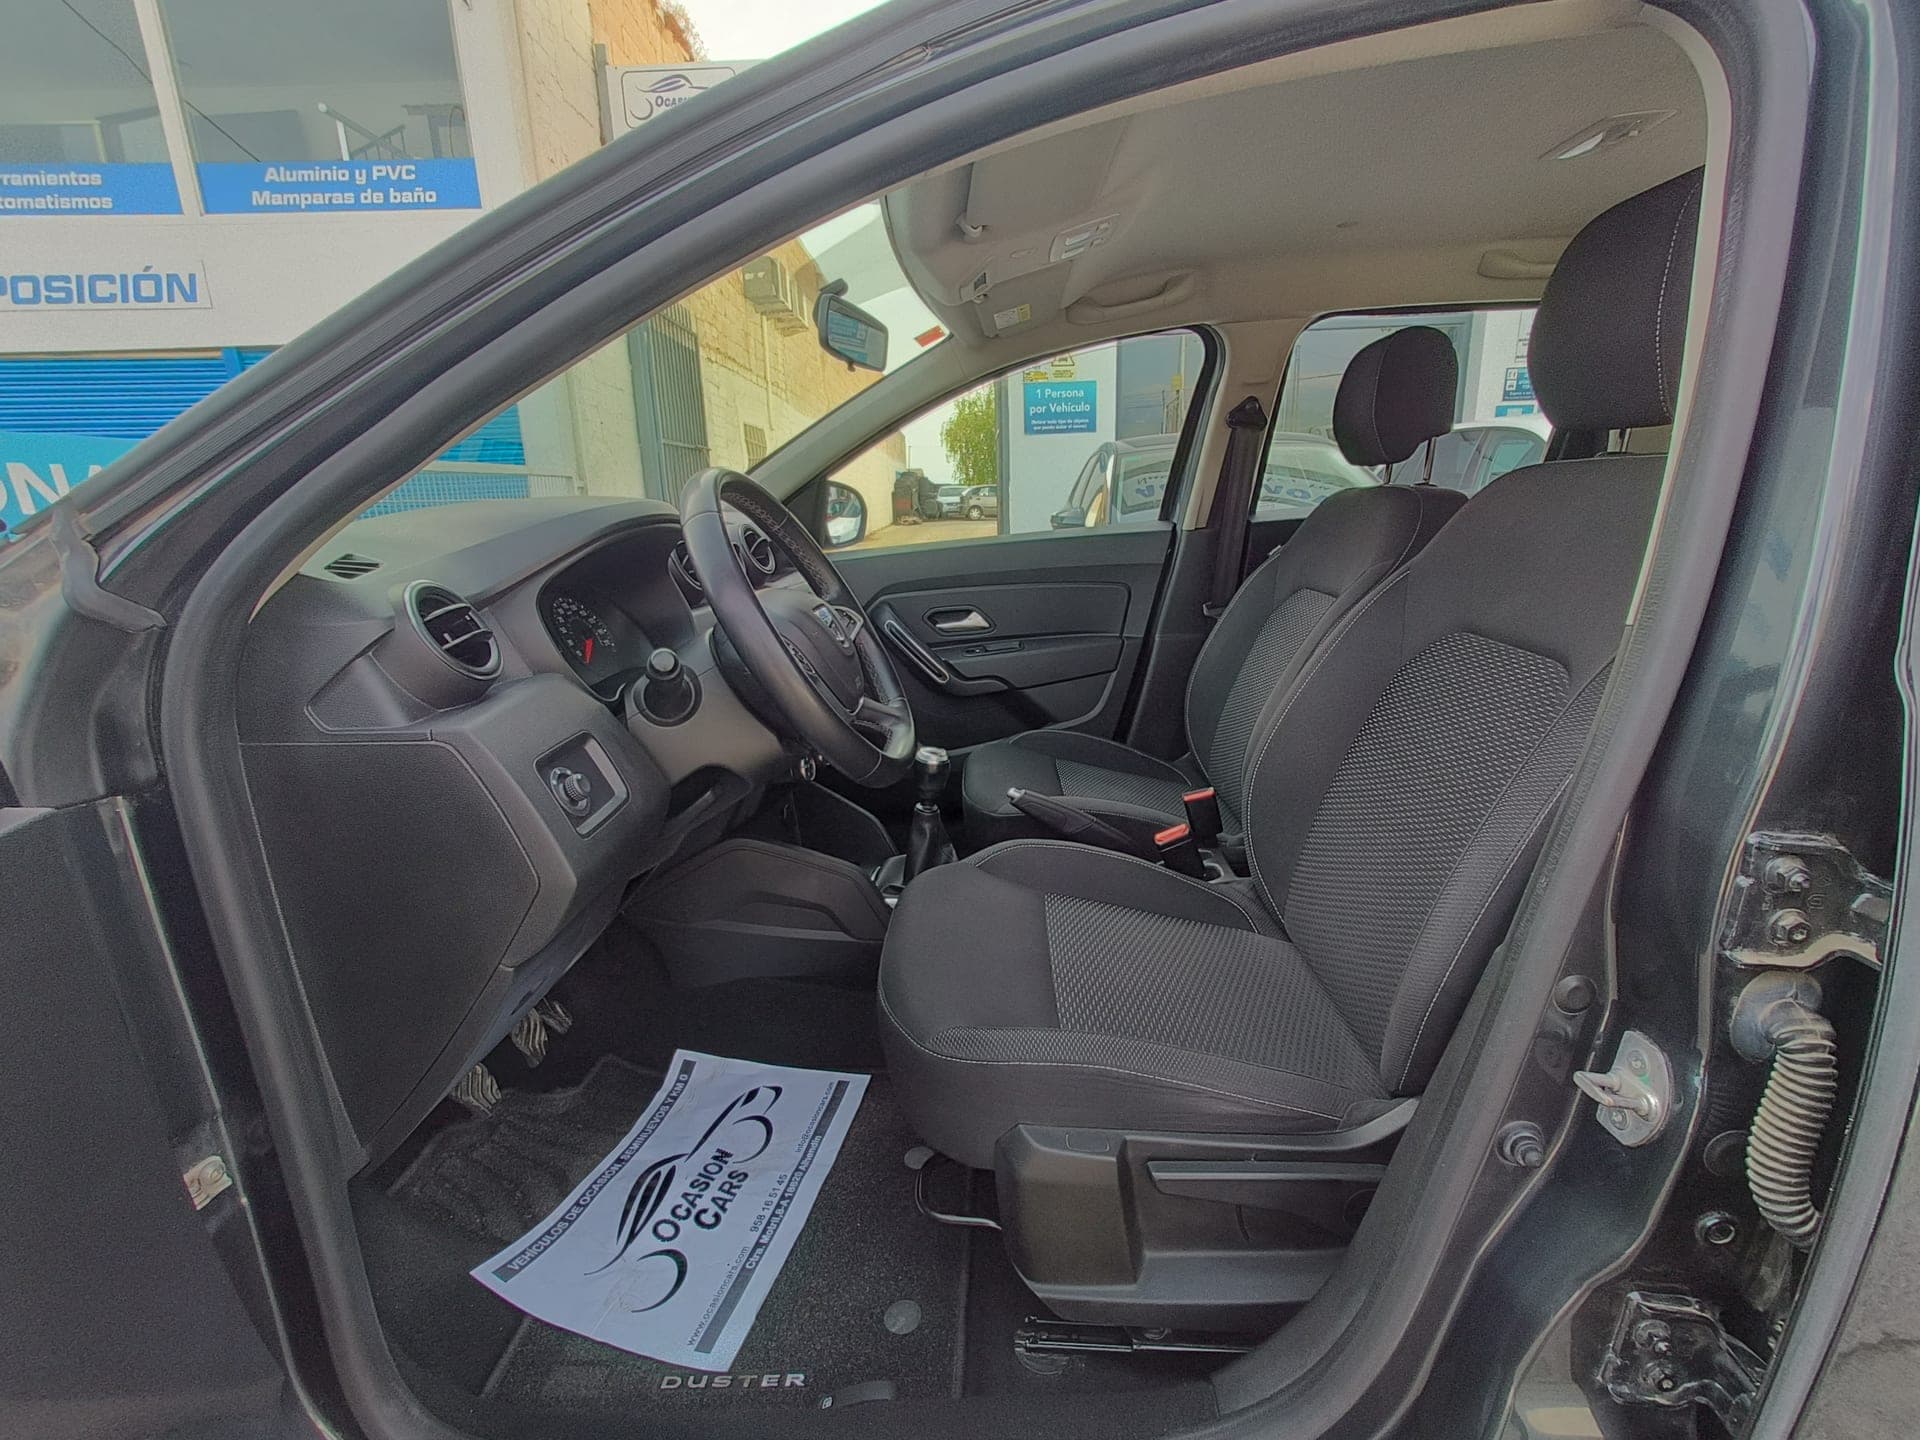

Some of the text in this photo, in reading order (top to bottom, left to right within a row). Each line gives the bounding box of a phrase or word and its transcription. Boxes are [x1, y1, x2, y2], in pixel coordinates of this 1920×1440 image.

[264, 165, 416, 185] Aluminio y PVC
[252, 187, 437, 209] Mamparas de baño
[0, 265, 198, 304] OSICIÓN
[1044, 388, 1084, 399] Persona
[1030, 402, 1090, 416] por Vehículo
[507, 1219, 569, 1271] VEHÍCULOS
[565, 1205, 584, 1221] DE
[665, 1096, 675, 1107] Y
[672, 1082, 686, 1097] KM
[652, 1148, 733, 1242] OCASION
[694, 1170, 749, 1230] CARS
[687, 1246, 749, 1346] www.ocasioncars.com
[750, 1214, 766, 1233] 958
[762, 1199, 774, 1213] 16
[768, 1186, 781, 1200] 51
[776, 1173, 788, 1187] 45
[745, 1244, 766, 1269] Ctra.
[660, 1373, 806, 1390] DUSTER
